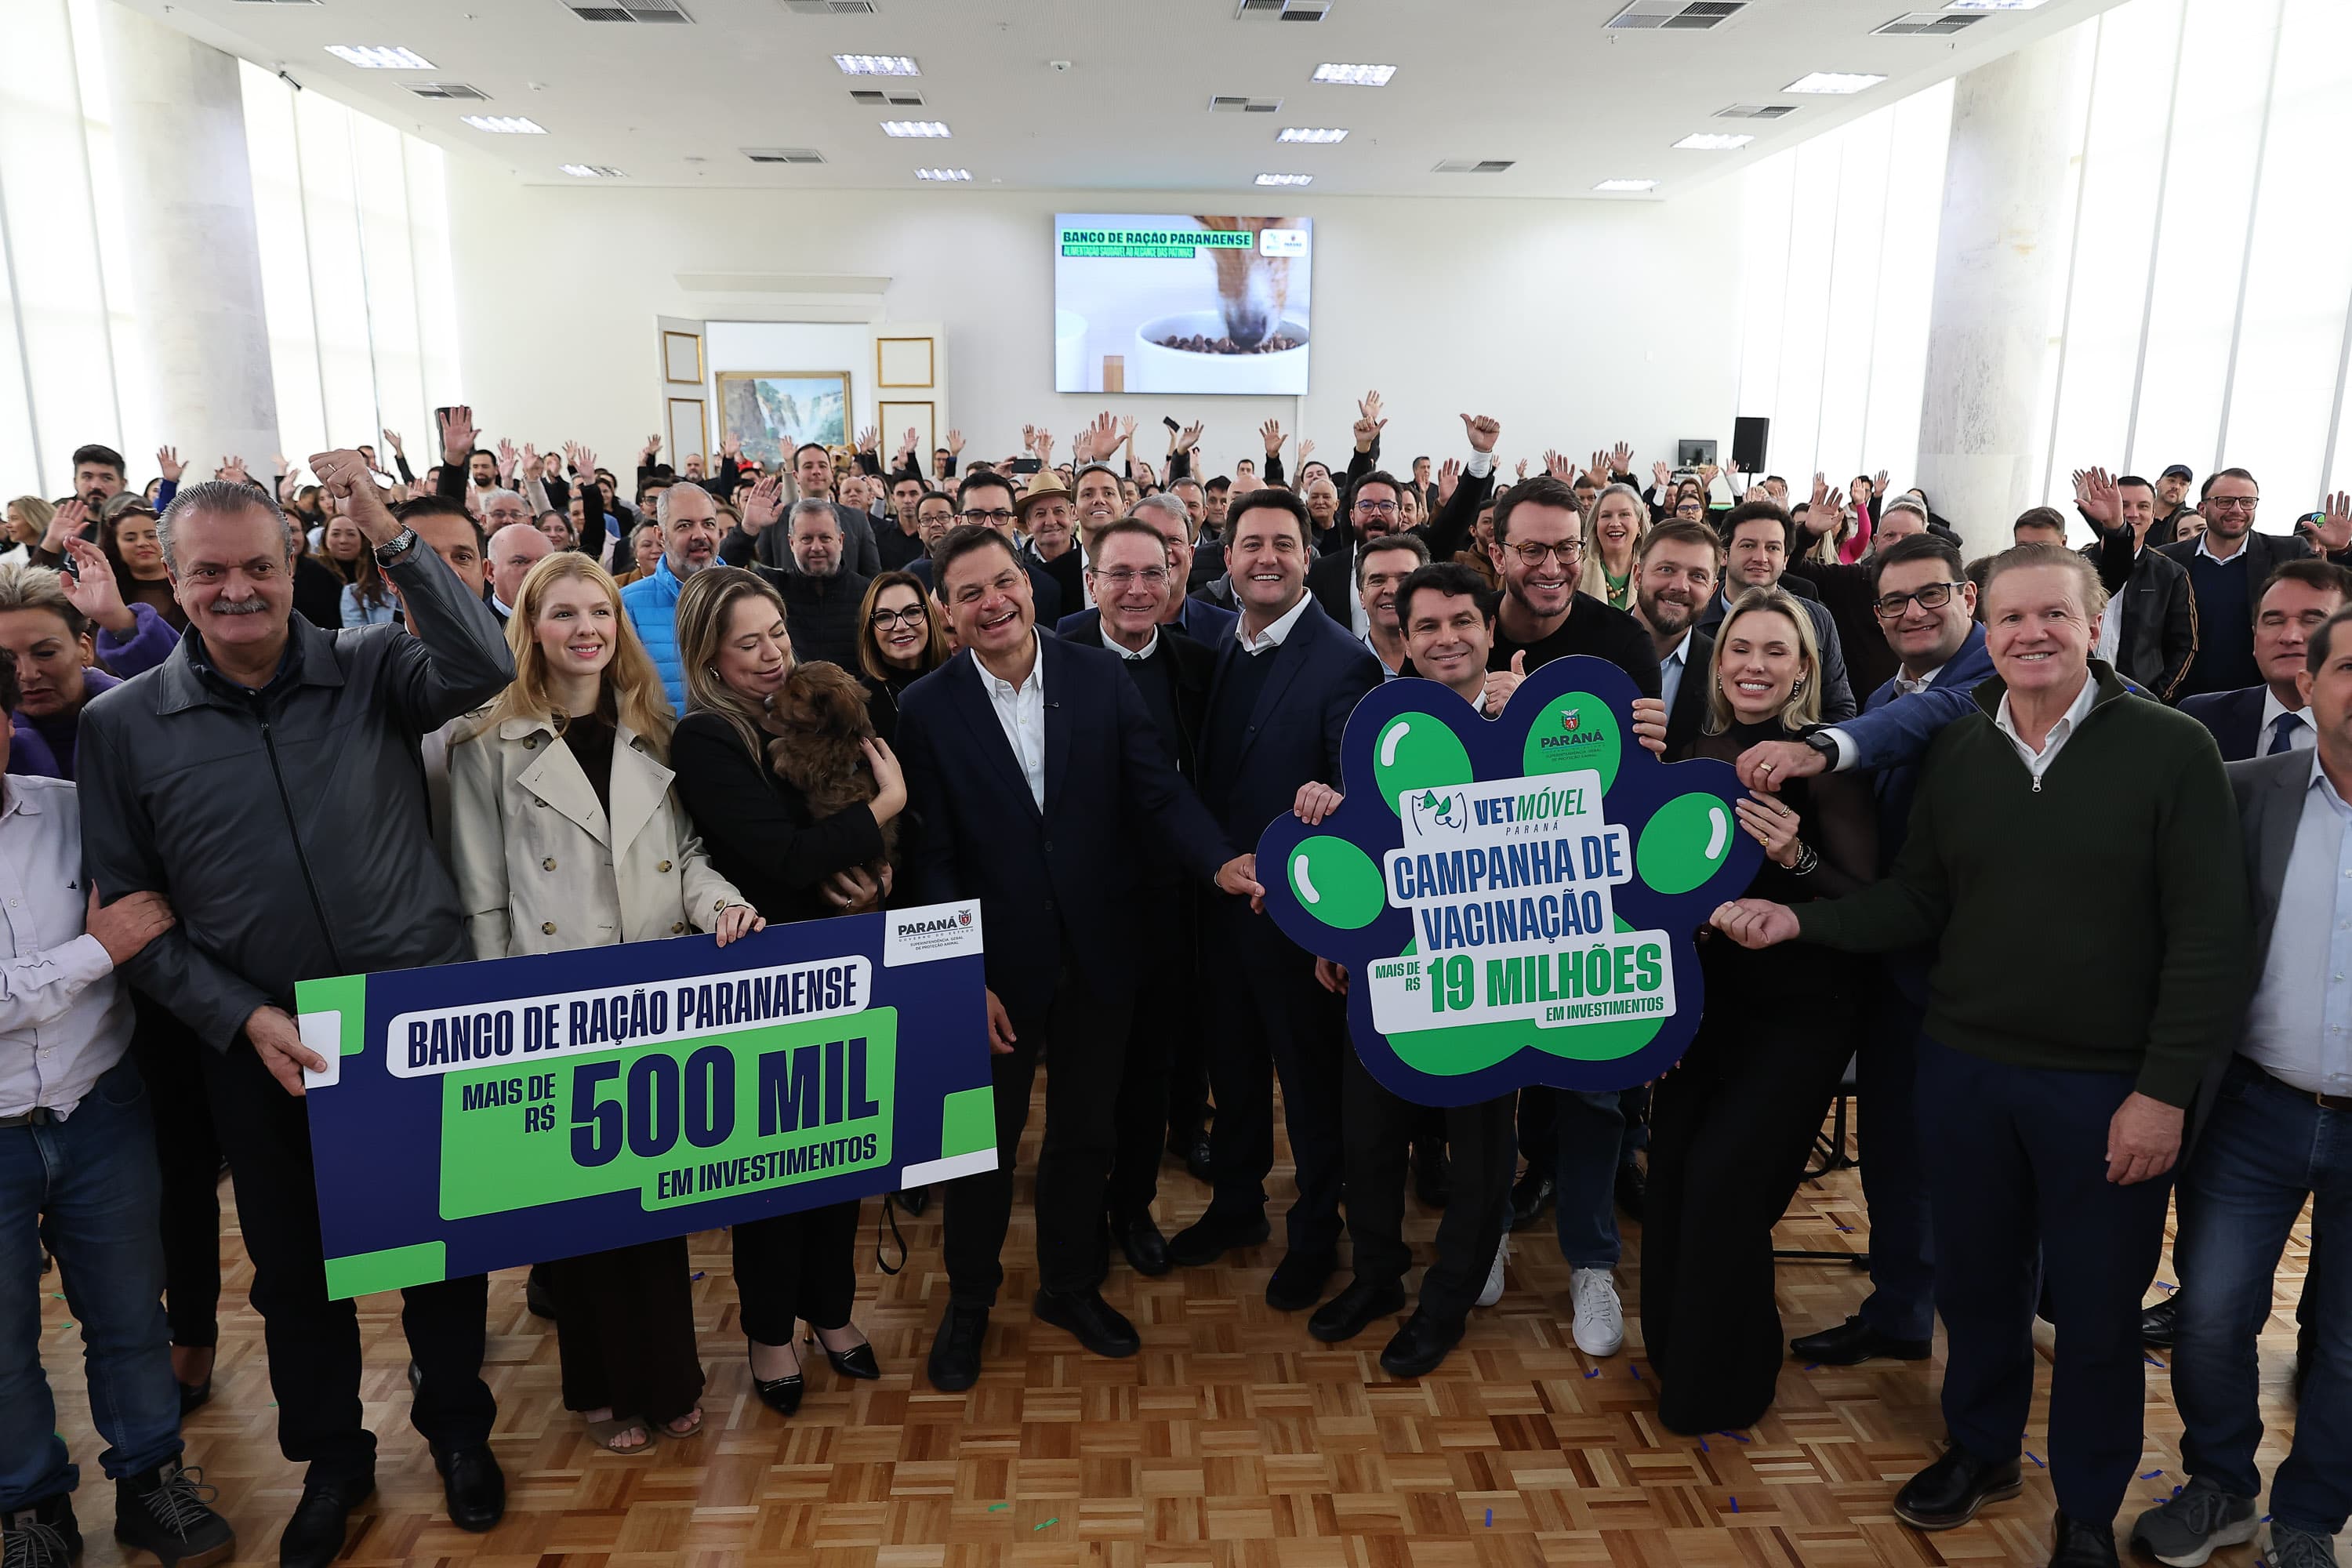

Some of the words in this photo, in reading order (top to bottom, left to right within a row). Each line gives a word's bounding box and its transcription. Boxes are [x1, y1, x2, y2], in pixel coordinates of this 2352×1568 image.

[1063, 231, 1105, 243] BANCO
[1108, 232, 1123, 243] DE
[1126, 230, 1167, 246] RAÇÃO
[1171, 233, 1250, 245] PARANAENSE
[1541, 729, 1604, 748] PARANÁ
[1473, 786, 1587, 826] VETMÓVEL
[1505, 820, 1559, 836] PARANÁ
[1393, 838, 1577, 900] CAMPANHA
[1581, 833, 1624, 880] DE
[898, 916, 957, 936] PARANÁ
[1421, 887, 1603, 951] VACINAÇÃO
[1375, 963, 1405, 979] MAIS
[1406, 960, 1421, 976] DE
[1405, 977, 1421, 992] R$
[1426, 954, 1475, 1014] 19
[1486, 942, 1663, 1007] MILHÕES
[408, 1010, 514, 1069] BANCO
[523, 1003, 560, 1053] DE
[569, 985, 668, 1047] RAÇÃO
[677, 964, 857, 1032] PARANAENSE
[1546, 1006, 1565, 1022] EM
[1566, 996, 1664, 1020] INVESTIMENTOS
[462, 1078, 523, 1112] MAIS
[528, 1073, 556, 1102] DE
[570, 1045, 735, 1167] 500
[758, 1036, 880, 1138] MIL
[524, 1102, 555, 1134] R$
[658, 1167, 694, 1200] EM
[699, 1133, 877, 1192] INVESTIMENTOS
